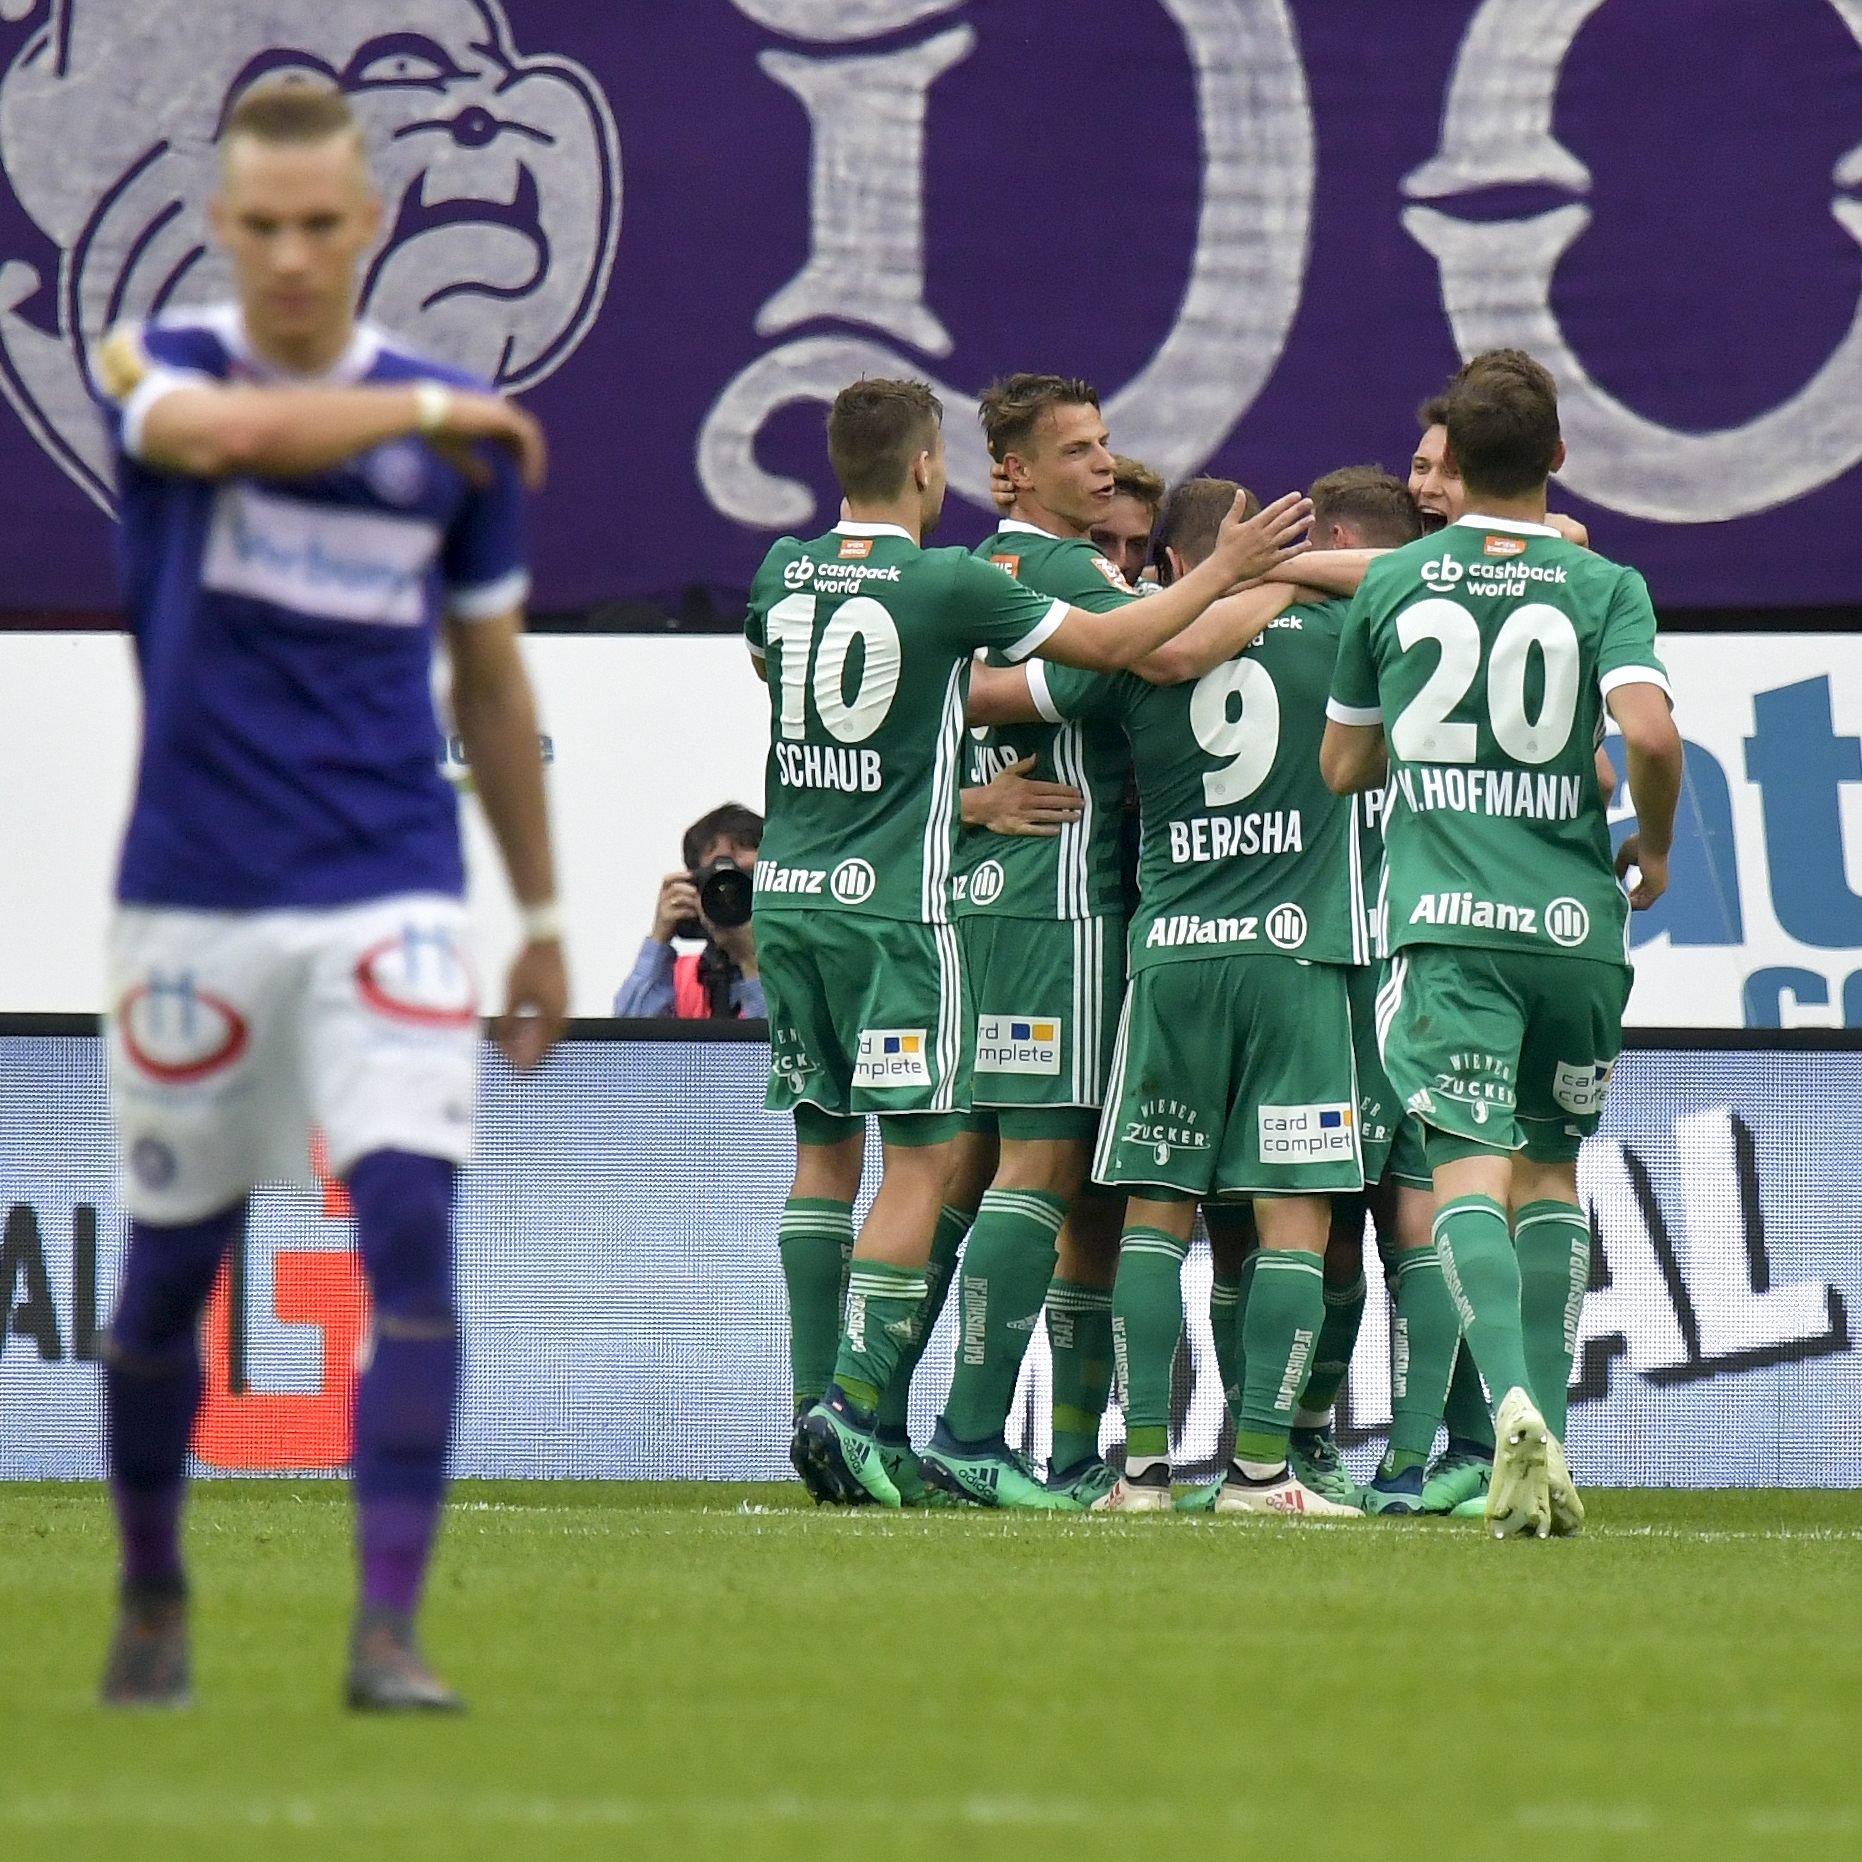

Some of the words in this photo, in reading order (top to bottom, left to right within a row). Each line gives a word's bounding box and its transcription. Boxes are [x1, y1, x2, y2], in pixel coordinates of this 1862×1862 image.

[813, 579, 861, 594] world
[818, 563, 901, 582] cashback
[1466, 579, 1526, 597] world
[1468, 562, 1568, 583] cashback
[767, 593, 901, 743] 10
[1391, 598, 1579, 764] 20
[1189, 657, 1280, 807] 9
[776, 742, 882, 792] SCHAUB
[1169, 809, 1303, 863] BERISHA
[753, 861, 827, 893] llianz
[1409, 892, 1538, 934] Allianz
[1146, 916, 1258, 949] Allianz
[1450, 1053, 1509, 1081] WIENER
[1140, 1099, 1197, 1125] WIENER
[1263, 1112, 1307, 1131] card
[1121, 1122, 1205, 1147] ZUCKER
[963, 1275, 988, 1366] RAPIDSHOP.AT
[1274, 1328, 1313, 1411] RAPIDSHOP.AT
